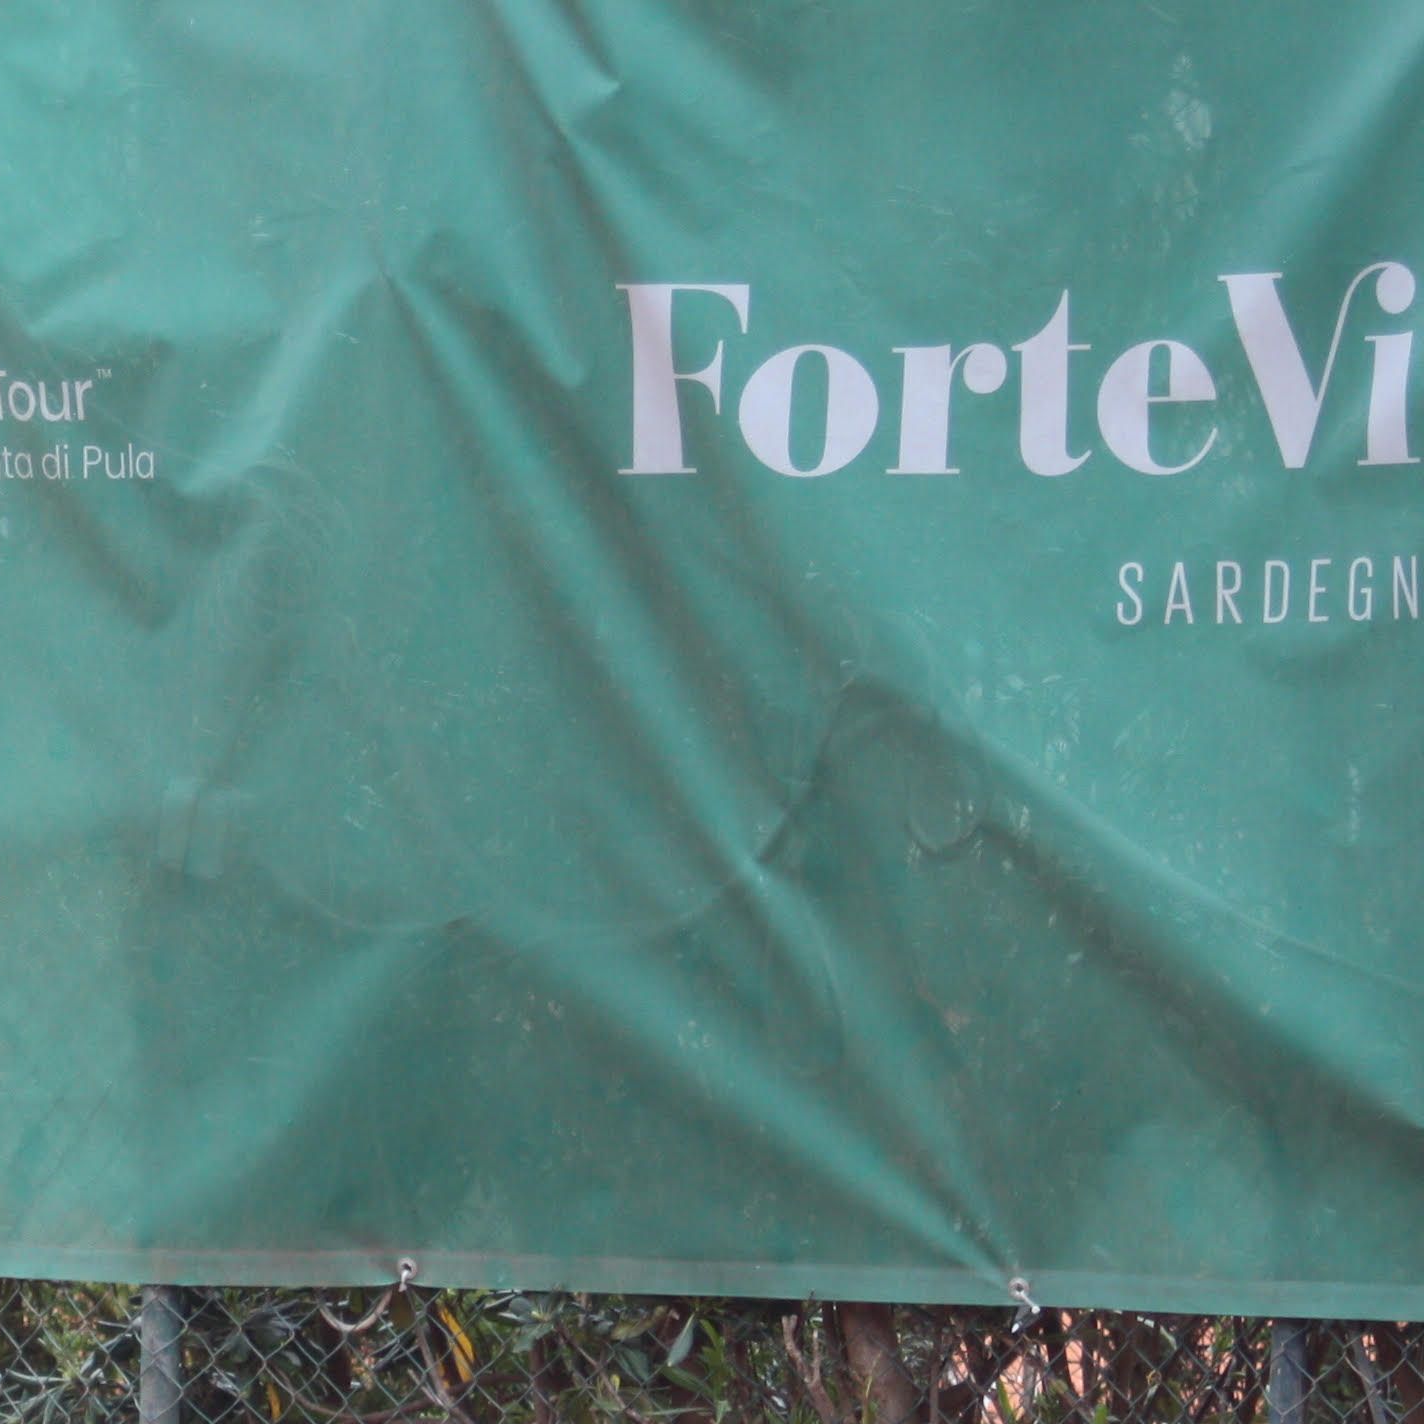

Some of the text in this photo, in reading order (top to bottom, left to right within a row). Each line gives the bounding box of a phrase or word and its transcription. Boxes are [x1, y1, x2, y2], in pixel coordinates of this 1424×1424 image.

[616, 261, 1420, 477] ForteVi
[42, 443, 70, 480] di
[83, 443, 154, 480] Pula
[1117, 555, 1419, 625] SARDEGN
